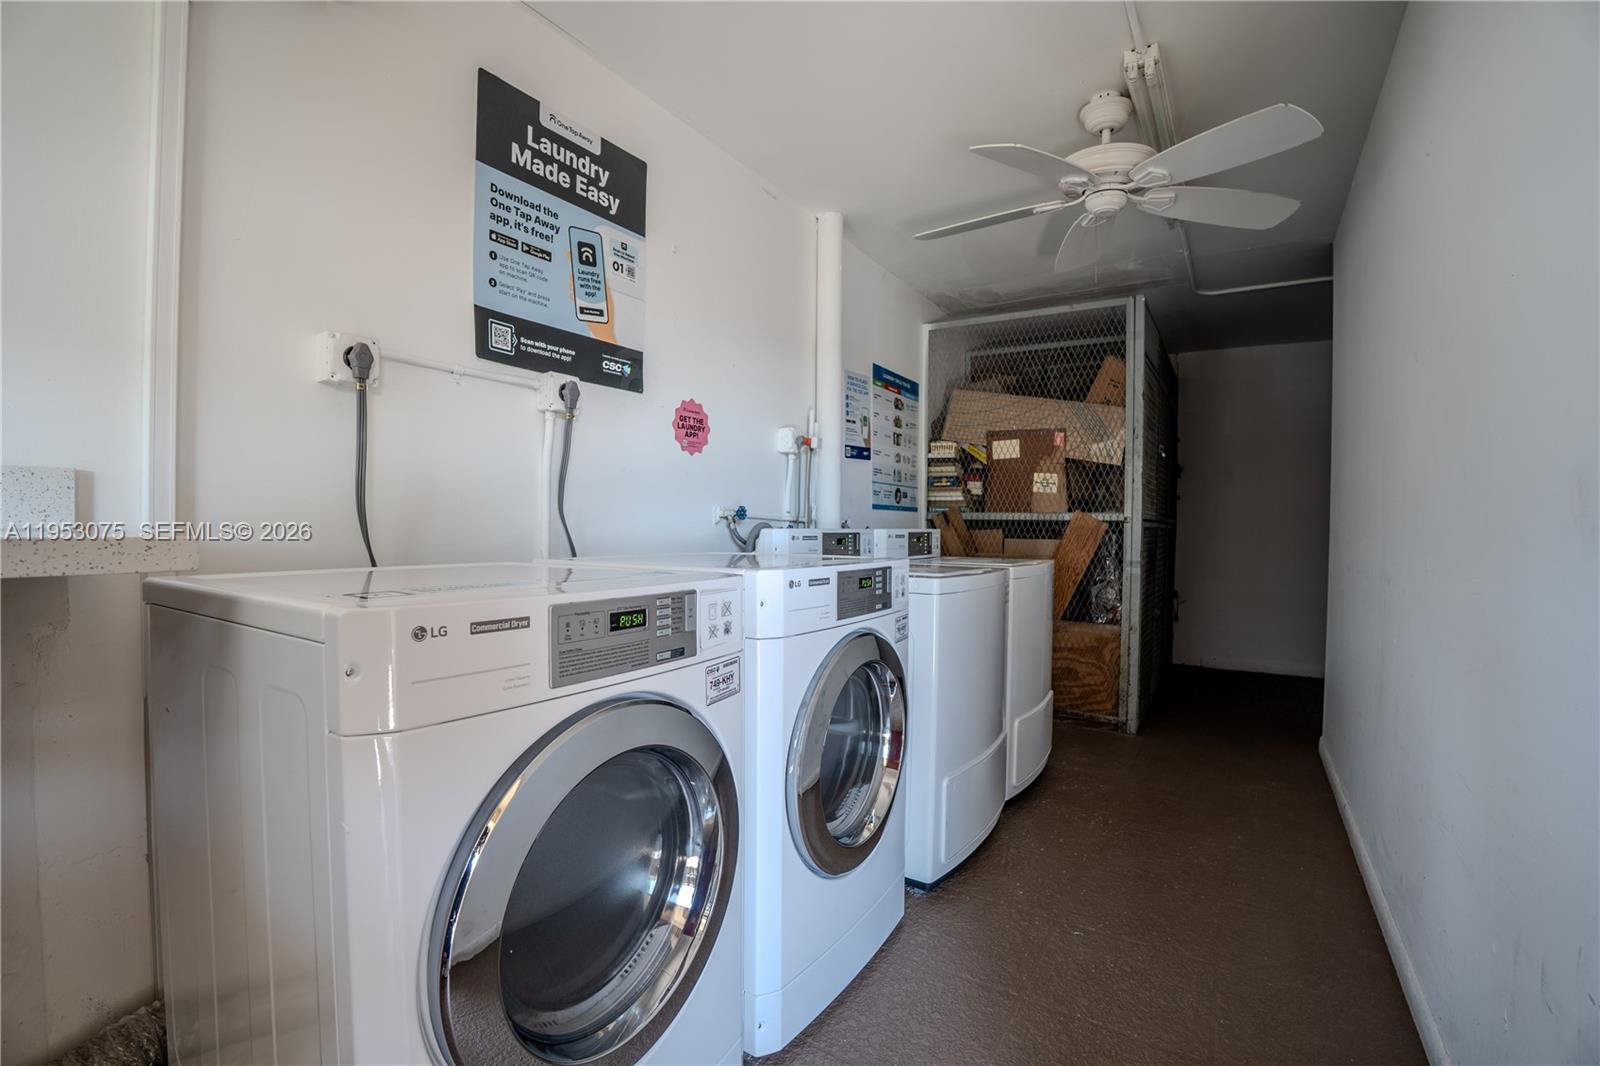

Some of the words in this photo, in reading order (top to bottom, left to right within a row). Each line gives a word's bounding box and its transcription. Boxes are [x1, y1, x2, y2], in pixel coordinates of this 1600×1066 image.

[527, 124, 610, 187] Laundry
[511, 142, 571, 188] Made
[576, 175, 620, 215] Easy
[490, 182, 541, 212] Download
[543, 206, 559, 220] the
[490, 197, 512, 213] One
[513, 206, 532, 223] Tap
[534, 215, 560, 235] Away
[489, 212, 513, 229] app,
[514, 220, 529, 234] it's
[531, 227, 554, 244] free!
[510, 258, 521, 266] One
[577, 268, 600, 279] Laundry
[577, 276, 590, 284] runs
[590, 277, 602, 285] free
[584, 290, 597, 298] app!
[591, 284, 601, 292] the
[520, 336, 535, 346] Scan
[534, 341, 547, 349] with
[547, 344, 560, 353] your
[559, 347, 576, 357] phone
[527, 346, 552, 358] download
[552, 352, 561, 360] the
[602, 360, 623, 372] CSC
[677, 422, 706, 433] LAUNDRY
[679, 415, 691, 423] GET
[692, 416, 704, 426] THE
[471, 620, 511, 633] Commercial
[511, 619, 529, 629] Dryer
[619, 613, 644, 627] PUSH
